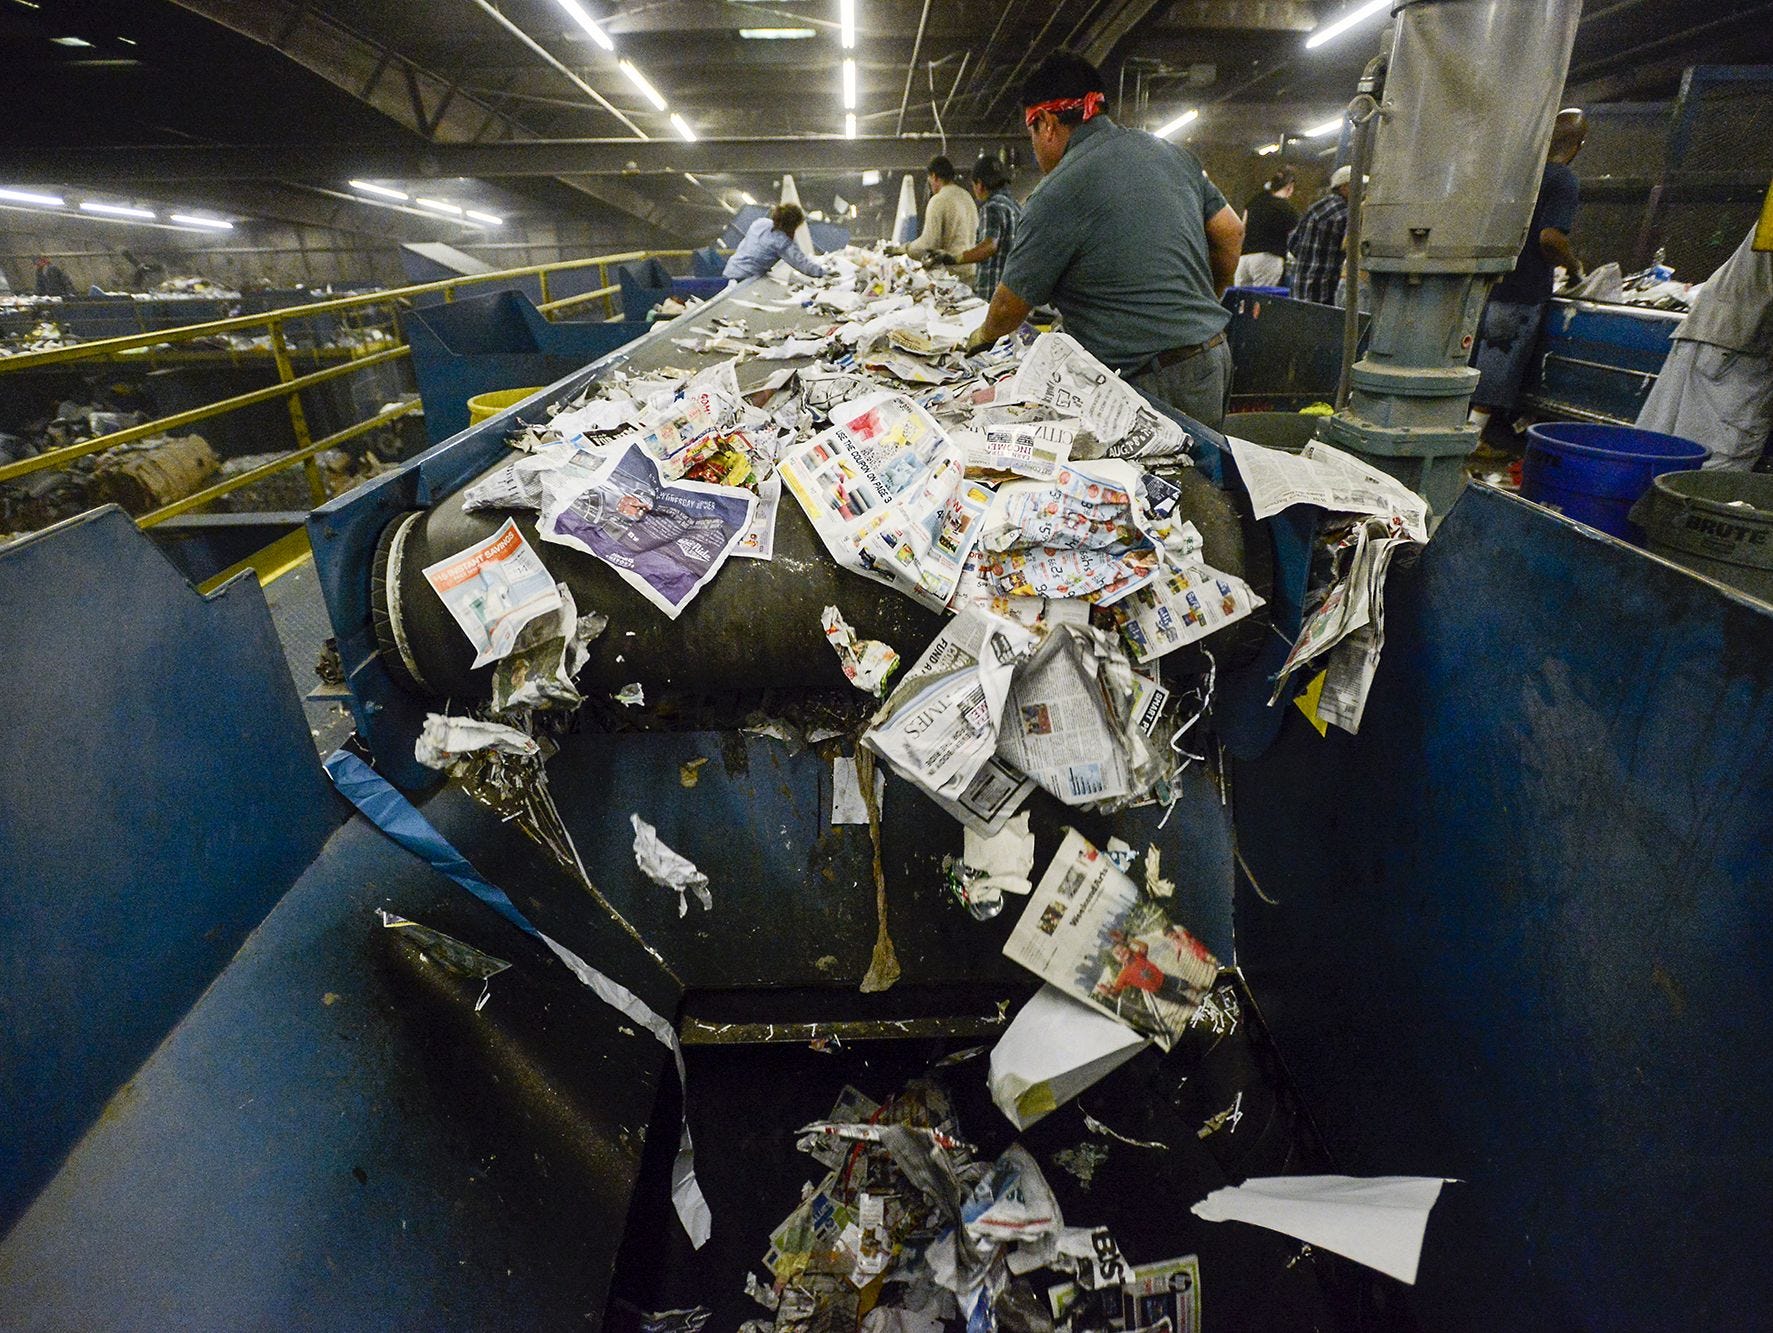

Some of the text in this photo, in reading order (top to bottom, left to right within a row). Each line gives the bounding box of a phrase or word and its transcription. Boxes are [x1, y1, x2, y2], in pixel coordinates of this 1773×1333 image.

[844, 440, 856, 452] THE
[851, 450, 871, 473] COUPON
[866, 471, 878, 482] ON
[873, 481, 889, 498] PAGE
[484, 531, 514, 558] SAVINGS
[1143, 692, 1165, 721] SMART
